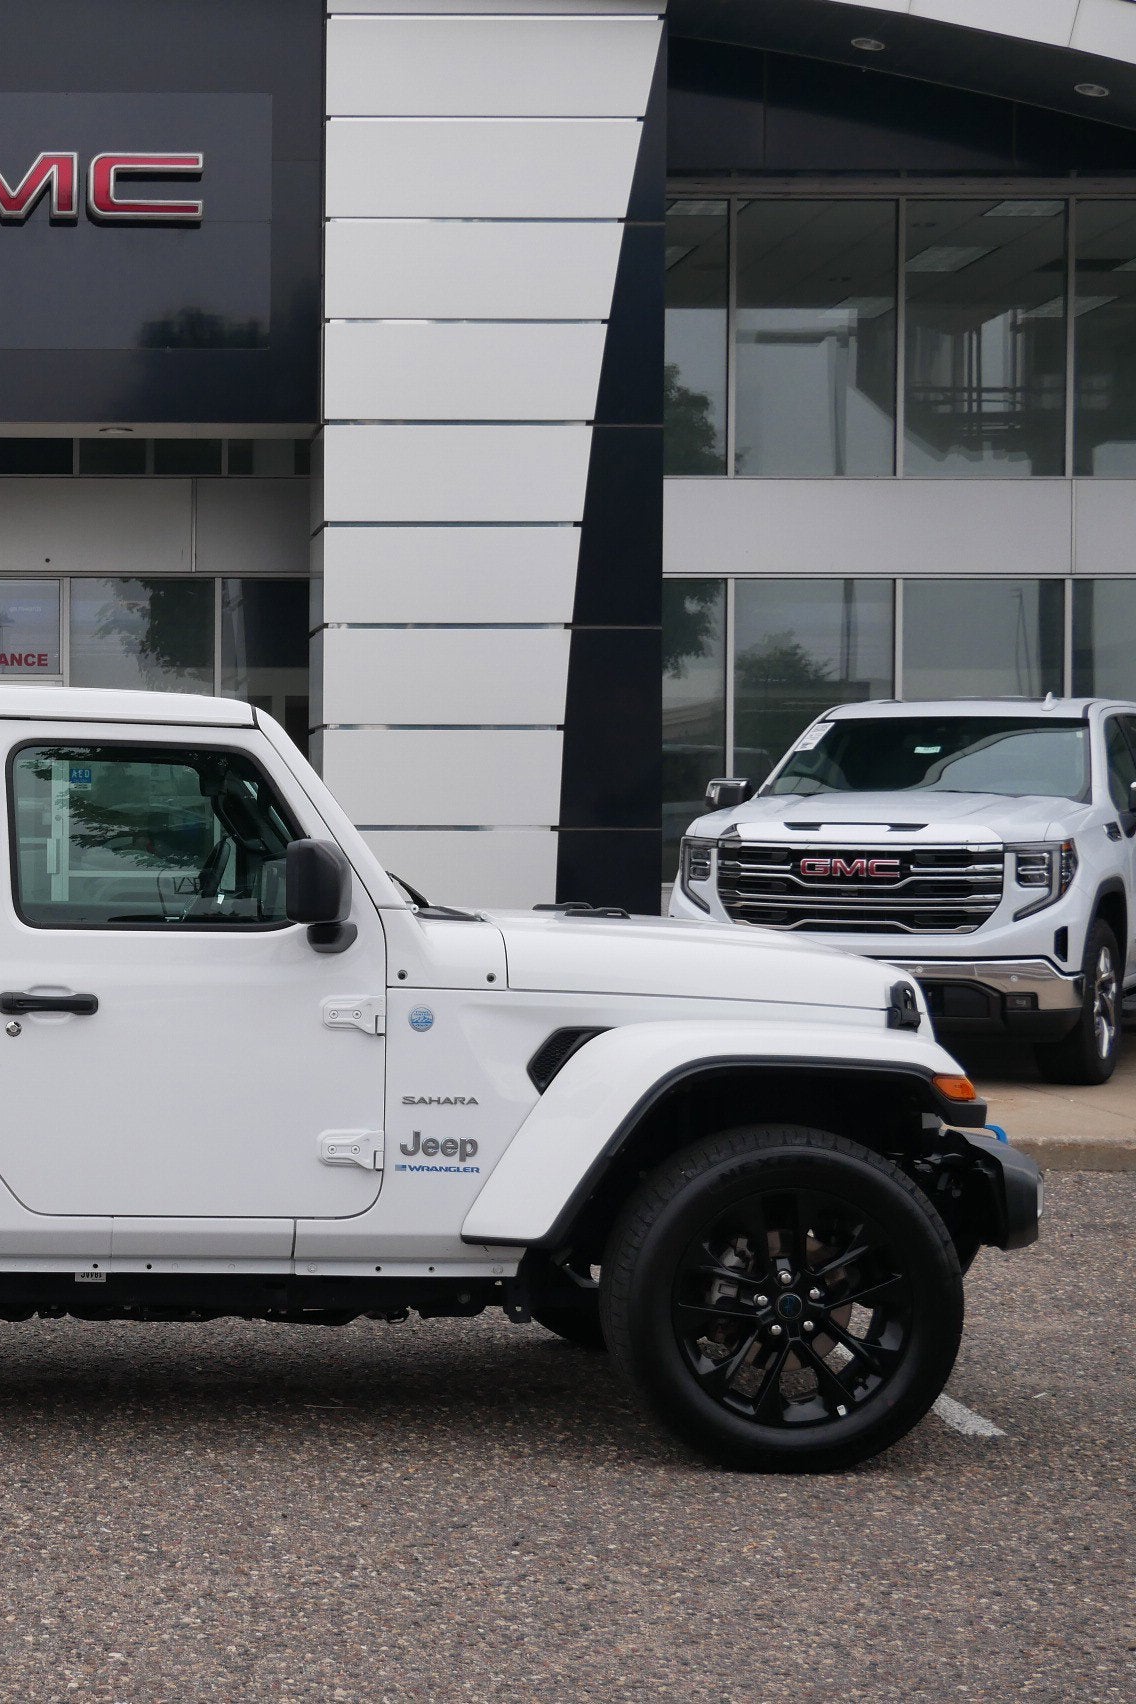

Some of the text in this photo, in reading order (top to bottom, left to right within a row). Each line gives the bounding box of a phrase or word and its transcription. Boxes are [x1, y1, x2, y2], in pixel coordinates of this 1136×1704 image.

[800, 858, 901, 878] GMC
[401, 1096, 479, 1105] SAHARA
[399, 1130, 479, 1162] Jeep
[407, 1164, 481, 1174] WRANGLER
